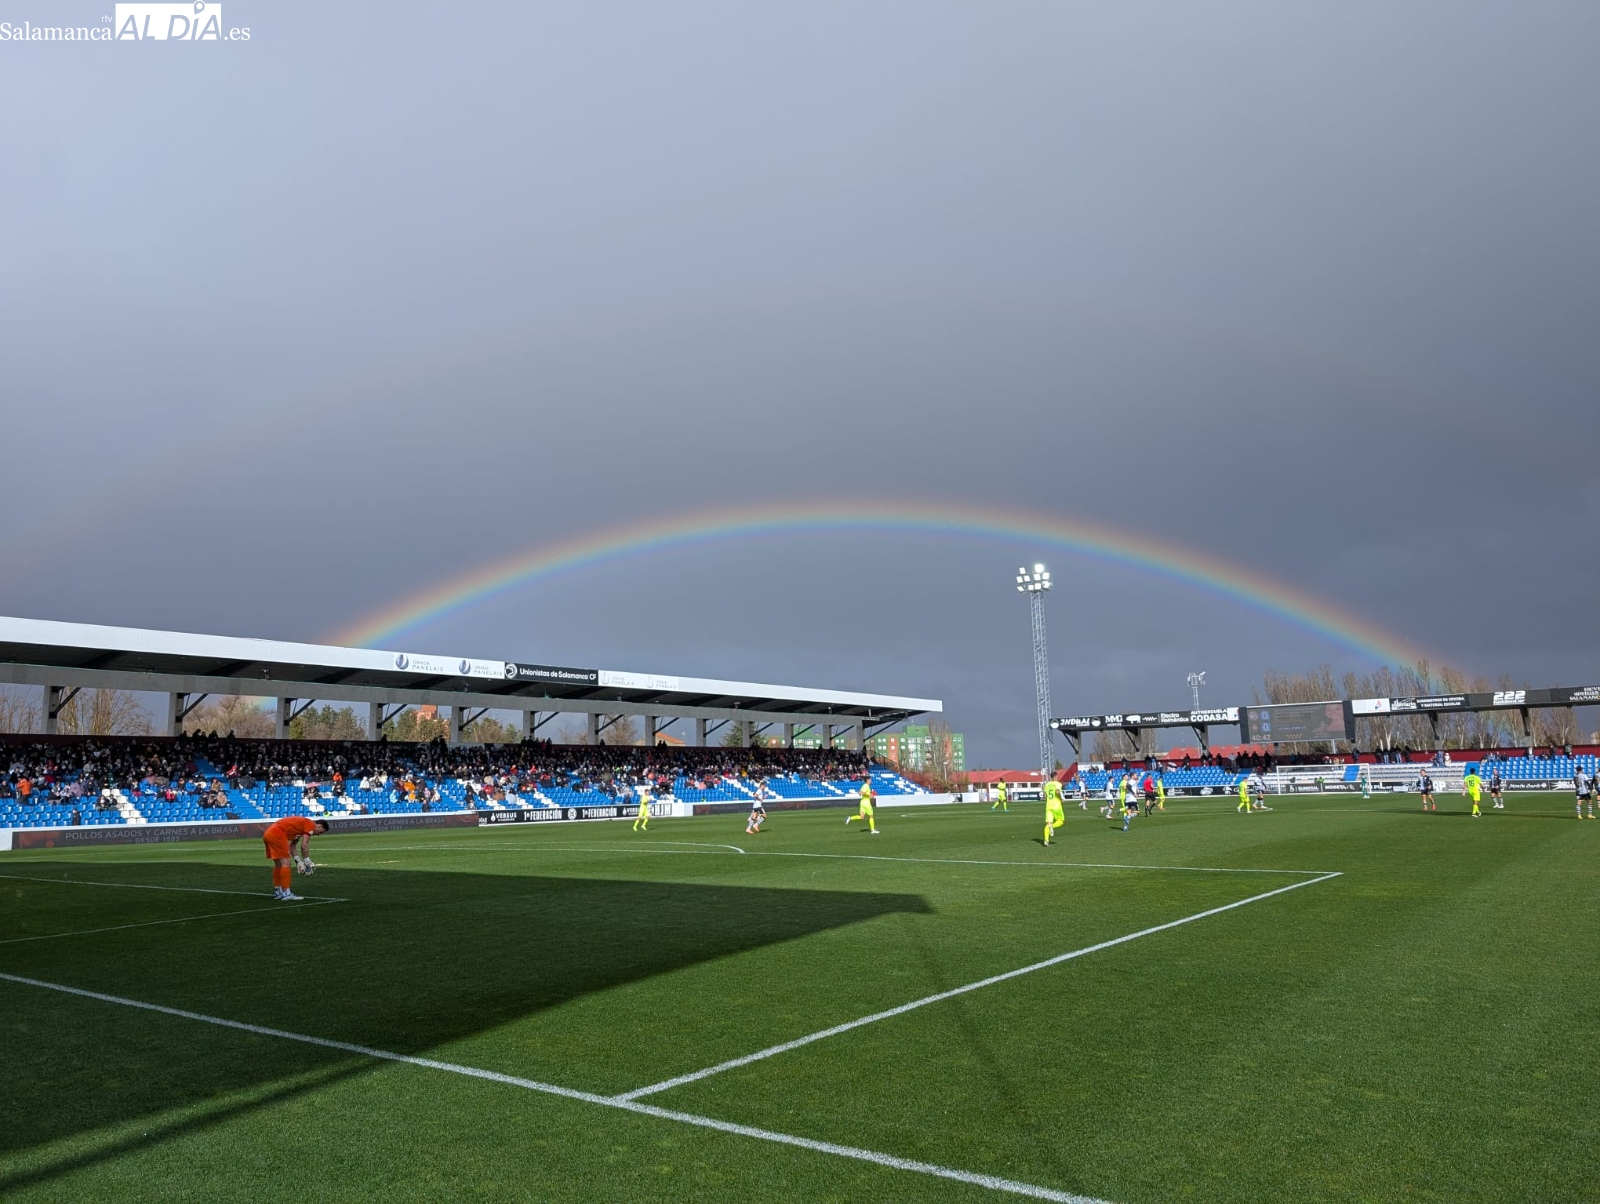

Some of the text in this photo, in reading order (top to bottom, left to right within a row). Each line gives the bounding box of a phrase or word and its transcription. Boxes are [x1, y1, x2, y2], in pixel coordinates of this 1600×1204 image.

[519, 667, 597, 681] Unionistas de Salamanca CF
[1493, 690, 1526, 700] 222
[1190, 713, 1228, 722] CODASA
[1261, 711, 1268, 720] 0
[1263, 723, 1269, 731] 0
[1048, 789, 1054, 800] 5
[530, 809, 563, 821] FEDERACIÓN
[350, 820, 376, 828] ASADOS
[65, 826, 239, 840] POLLOS ASADOS Y CARNES A LA BRASA
